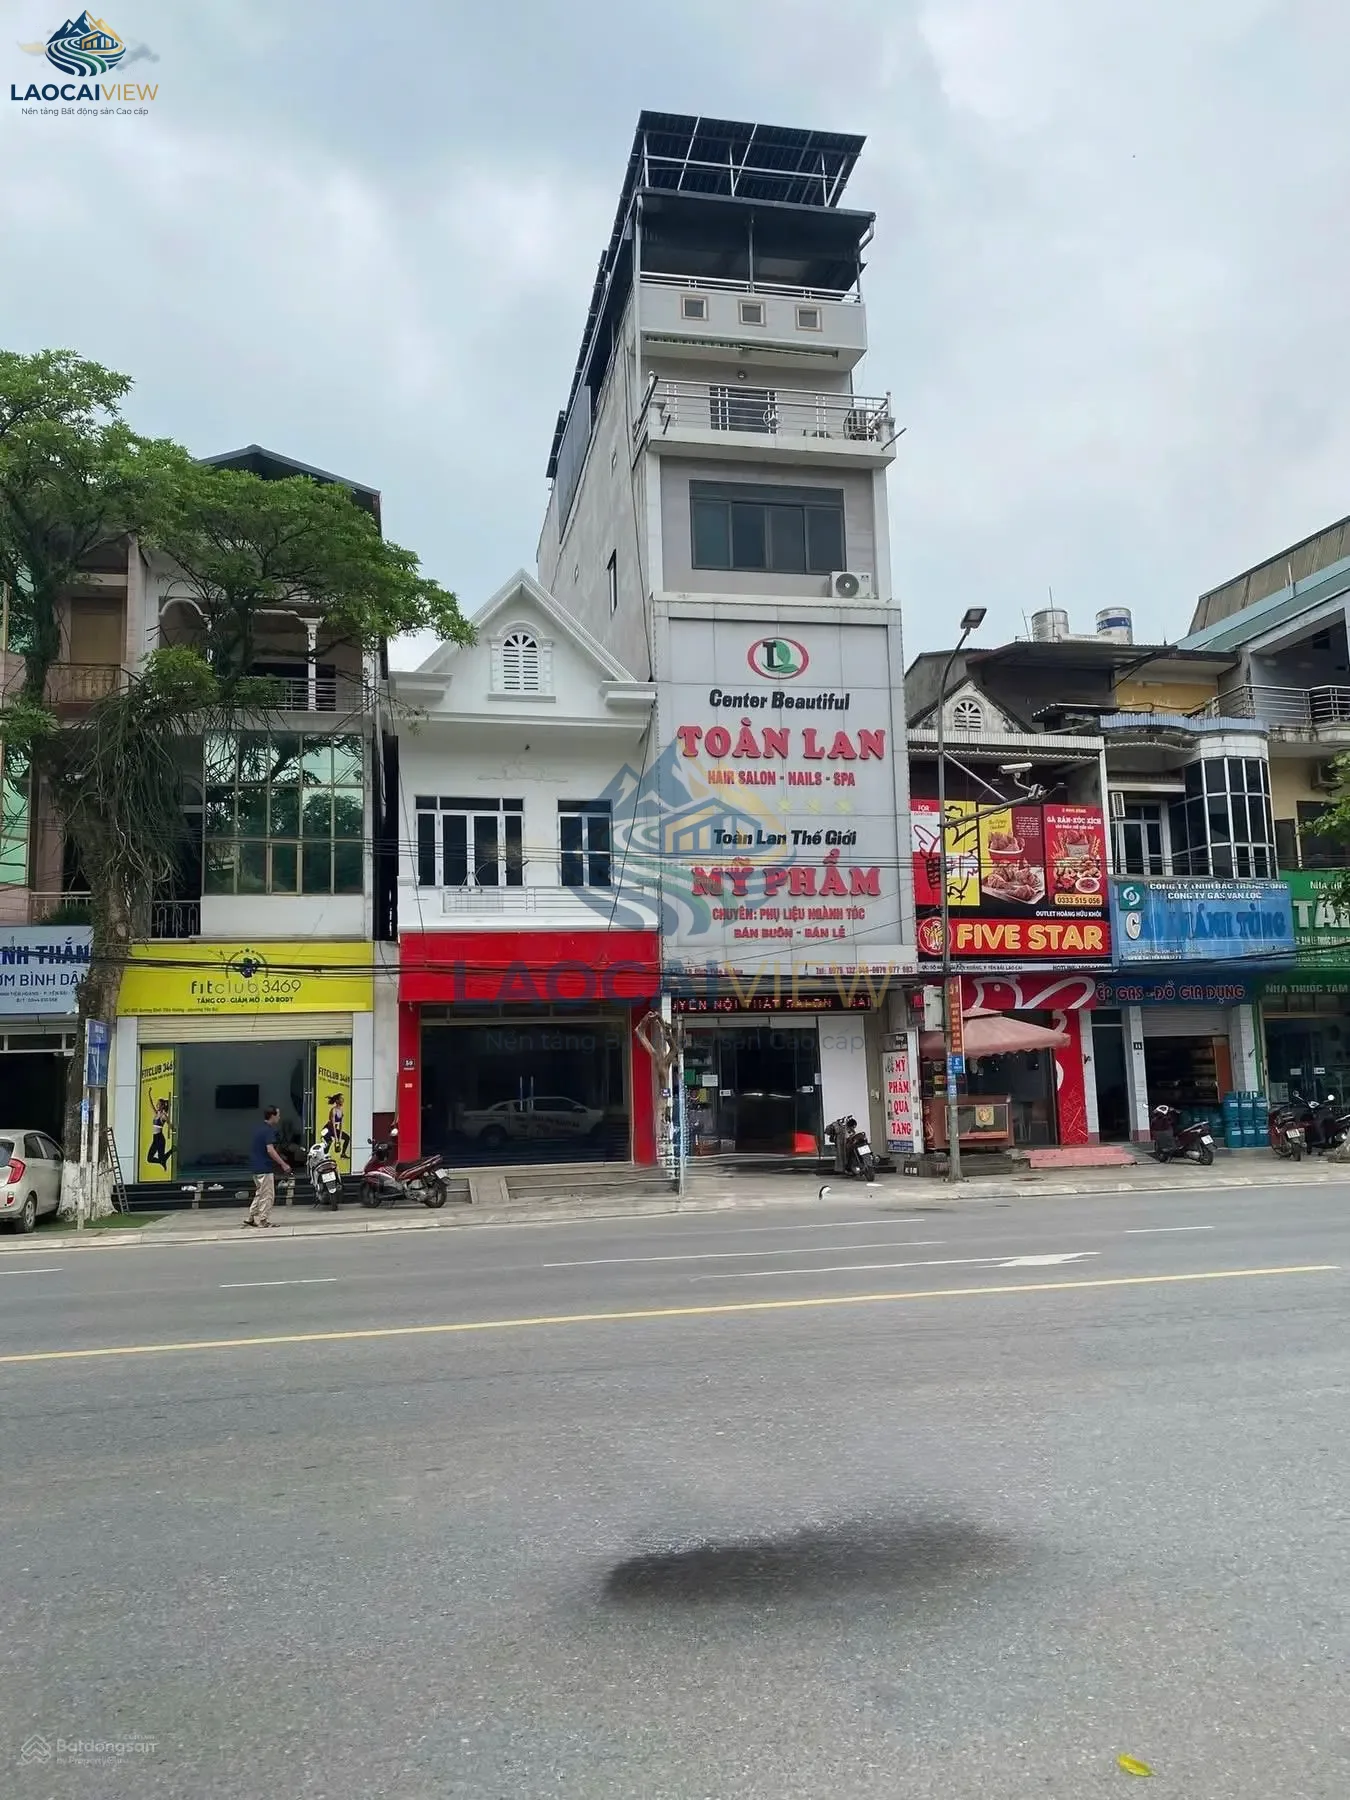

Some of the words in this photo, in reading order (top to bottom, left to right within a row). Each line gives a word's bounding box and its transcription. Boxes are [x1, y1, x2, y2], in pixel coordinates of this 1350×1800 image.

[709, 689, 768, 708] Center
[771, 691, 850, 710] Beautiful
[677, 717, 790, 759] TOÀN
[802, 728, 885, 760] LAN
[708, 770, 735, 785] HAIR
[738, 770, 776, 786] SALON
[788, 771, 822, 786] NAILS
[833, 771, 856, 786] SPA
[714, 829, 753, 845] Toàn
[756, 830, 787, 845] Lan
[791, 829, 822, 846] Thế
[825, 830, 857, 845] Giới
[763, 848, 881, 896] PHẨM
[783, 906, 805, 922] LIỆU
[957, 923, 1020, 949] FIVE
[1028, 924, 1103, 950] STAR
[191, 980, 258, 994] fitclub
[262, 980, 301, 994] 3469
[1117, 985, 1144, 1000] GAS
